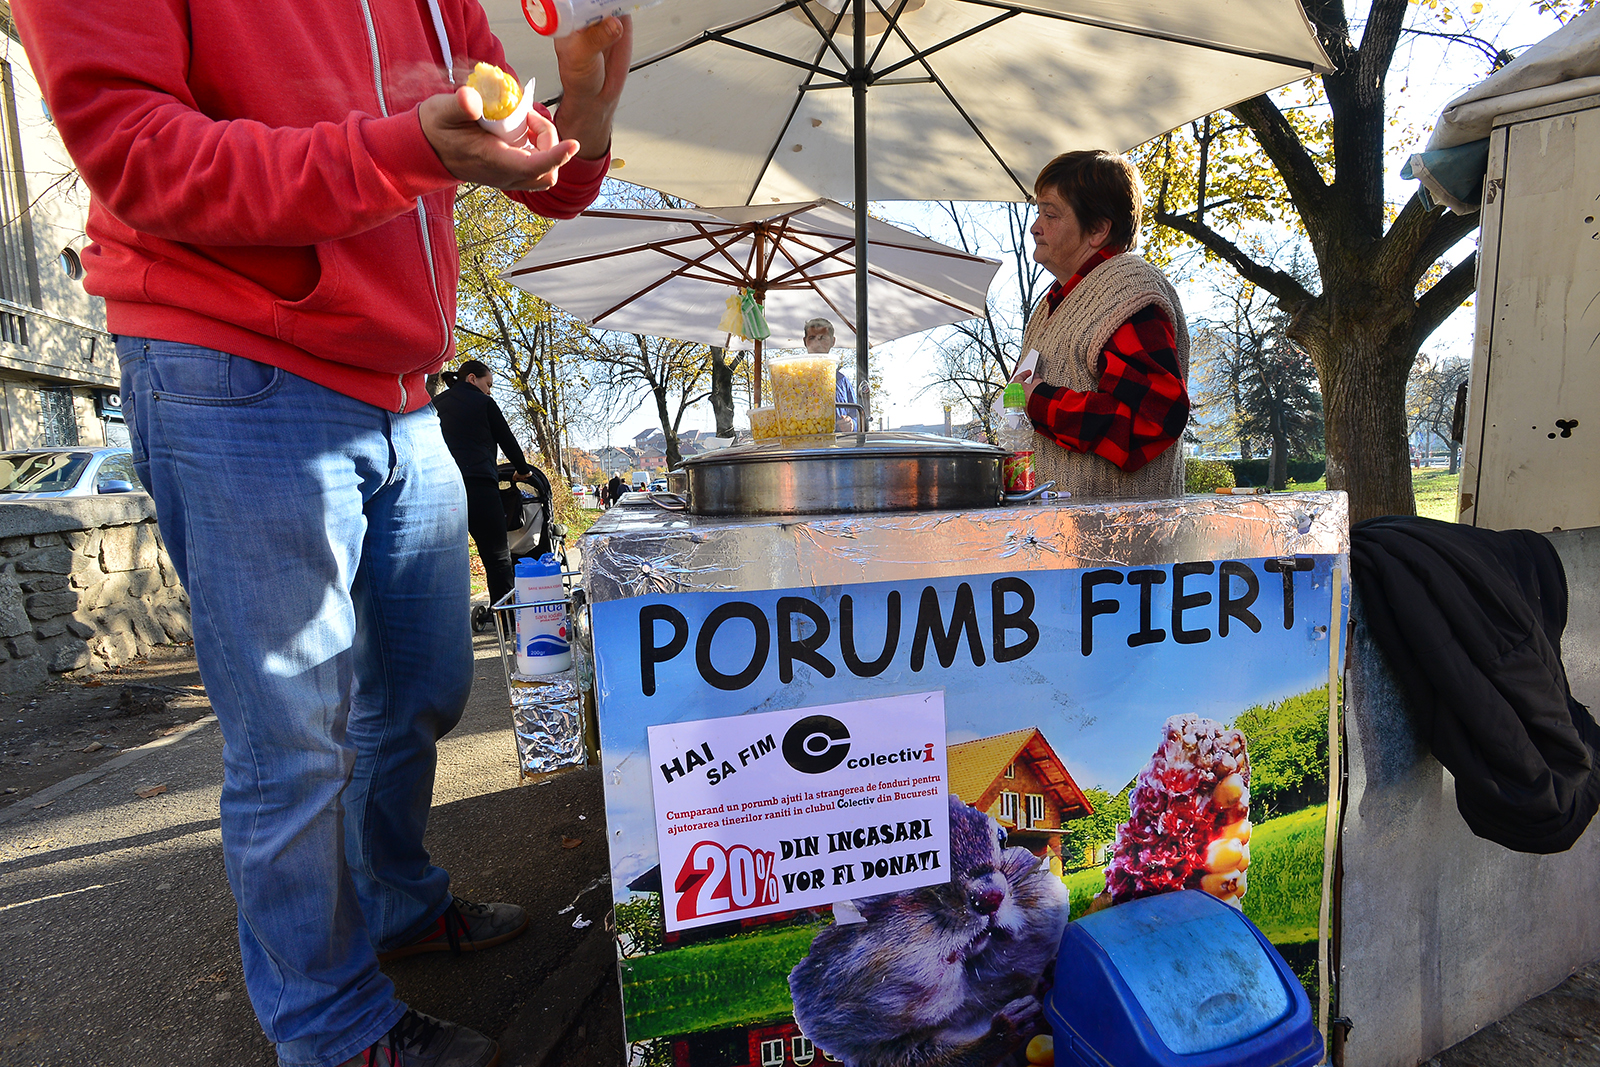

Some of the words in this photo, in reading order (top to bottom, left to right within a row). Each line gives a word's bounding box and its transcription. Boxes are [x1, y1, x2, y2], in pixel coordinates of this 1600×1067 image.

[638, 576, 1040, 697] PORUMB
[1080, 557, 1315, 656] FIERT
[659, 741, 715, 784] HAI
[706, 760, 737, 786] SA
[737, 733, 777, 767] FIM
[846, 743, 935, 769] colectivi
[666, 804, 724, 820] Cumparand
[726, 804, 739, 812] un
[741, 796, 779, 812] porumb
[781, 792, 803, 806] ajuti
[804, 792, 814, 800] la
[816, 785, 865, 799] strangerea
[866, 783, 877, 792] de
[878, 777, 911, 790] fonduri
[912, 775, 941, 787] pentru
[667, 820, 719, 835] ajutorarea
[721, 814, 763, 826] tinerilor
[764, 808, 791, 820] raniti
[793, 806, 803, 815] in
[805, 801, 836, 814] clubul
[837, 796, 875, 809] Colectiv
[877, 793, 892, 803] din
[894, 786, 939, 801] Bucuresti
[778, 836, 820, 862] DIN
[827, 818, 933, 853] INCASARI
[675, 840, 780, 922] 20%
[781, 866, 826, 894] VOR
[831, 863, 856, 886] FI
[860, 850, 941, 882] DONATI
